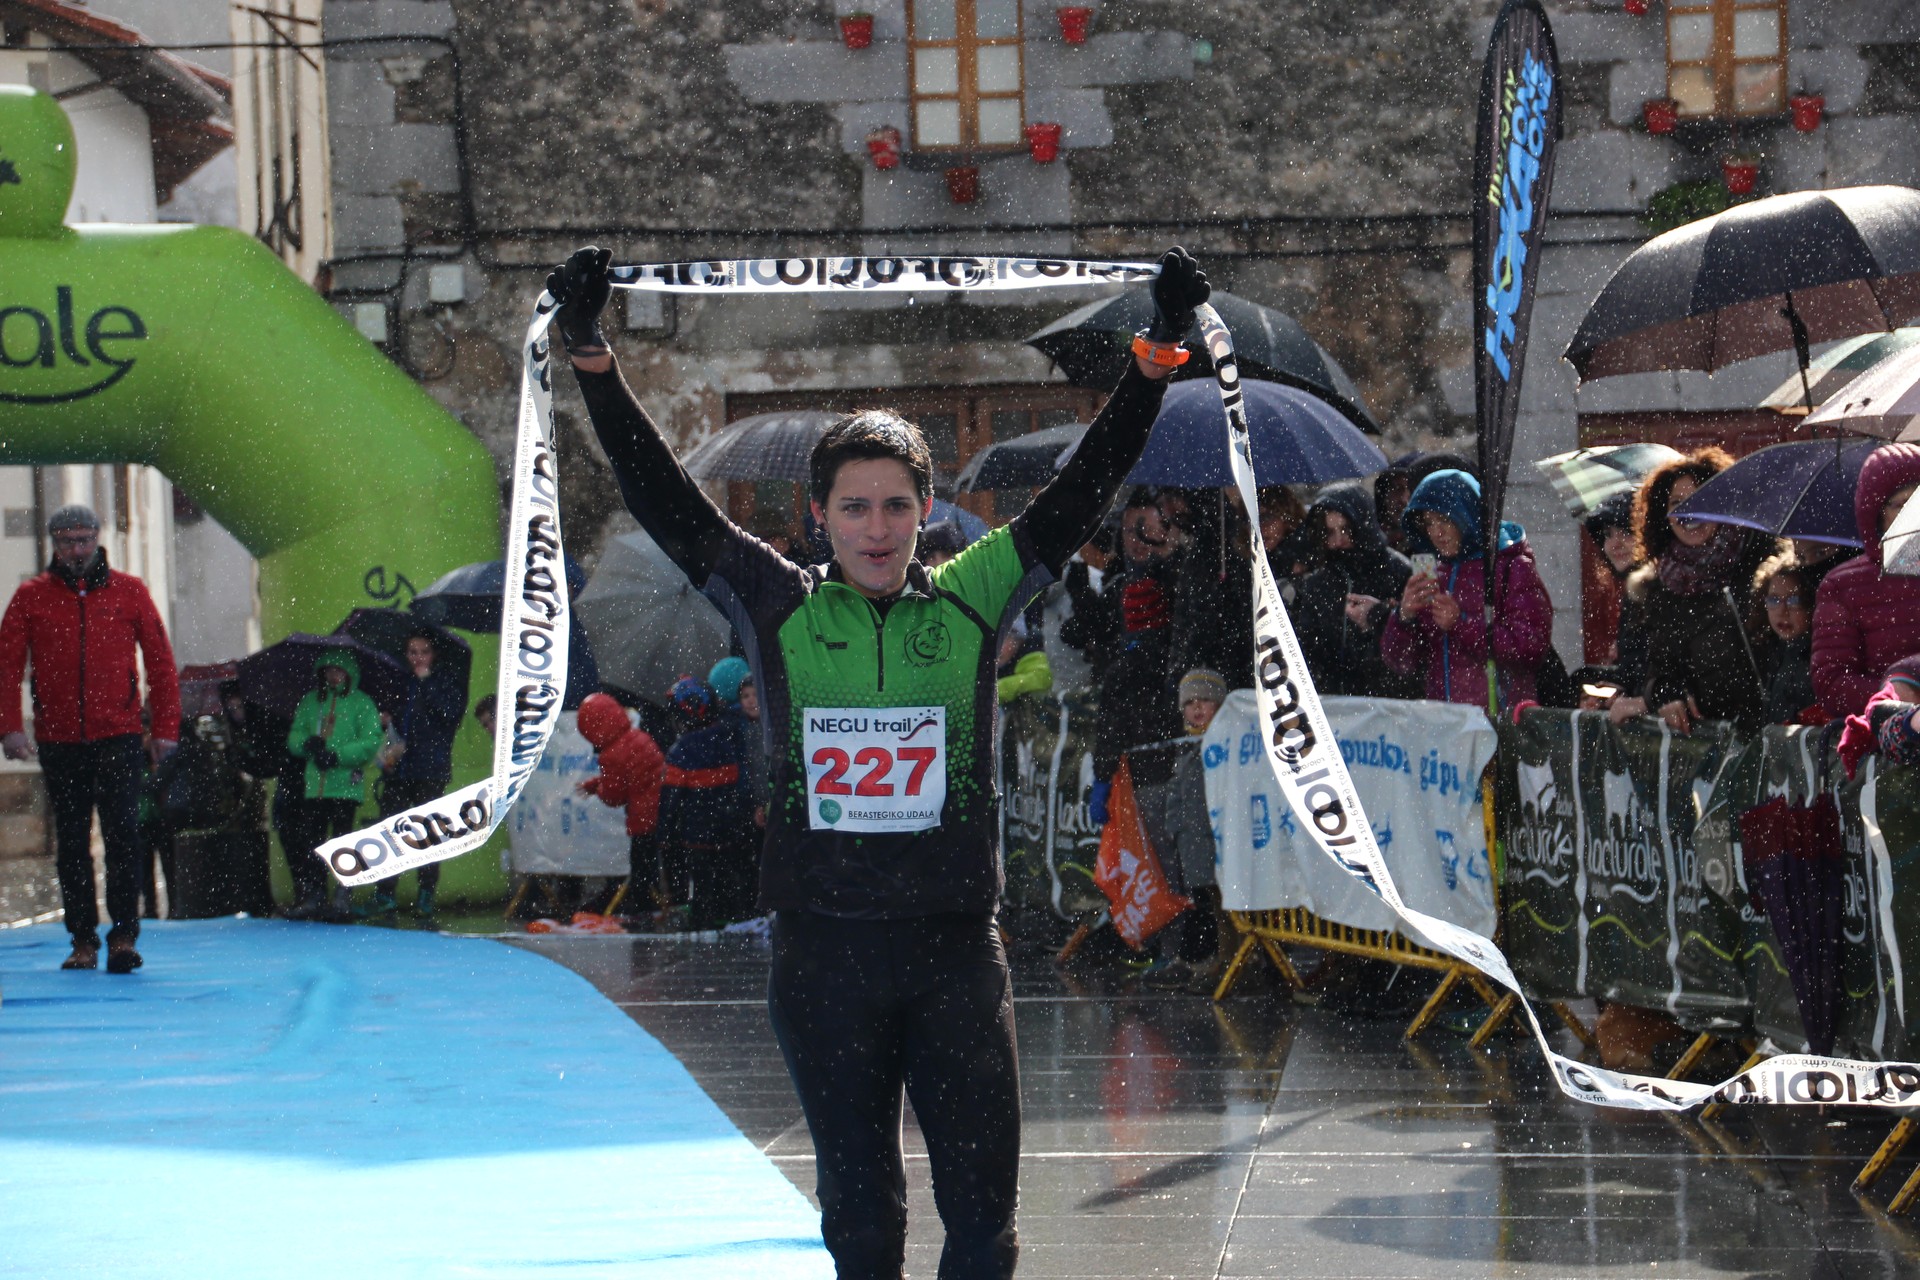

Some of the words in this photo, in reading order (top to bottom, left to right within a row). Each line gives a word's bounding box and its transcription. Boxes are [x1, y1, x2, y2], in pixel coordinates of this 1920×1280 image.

[1510, 47, 1536, 145] ONE
[1527, 58, 1553, 158] ONE
[1485, 141, 1541, 382] HOKA
[1275, 612, 1308, 686] www.ataria.eus
[810, 717, 868, 733] NEGU
[873, 717, 911, 733] trail
[811, 746, 937, 797] 227
[848, 810, 903, 819] BERASTEGIKO
[907, 810, 935, 818] UDALA
